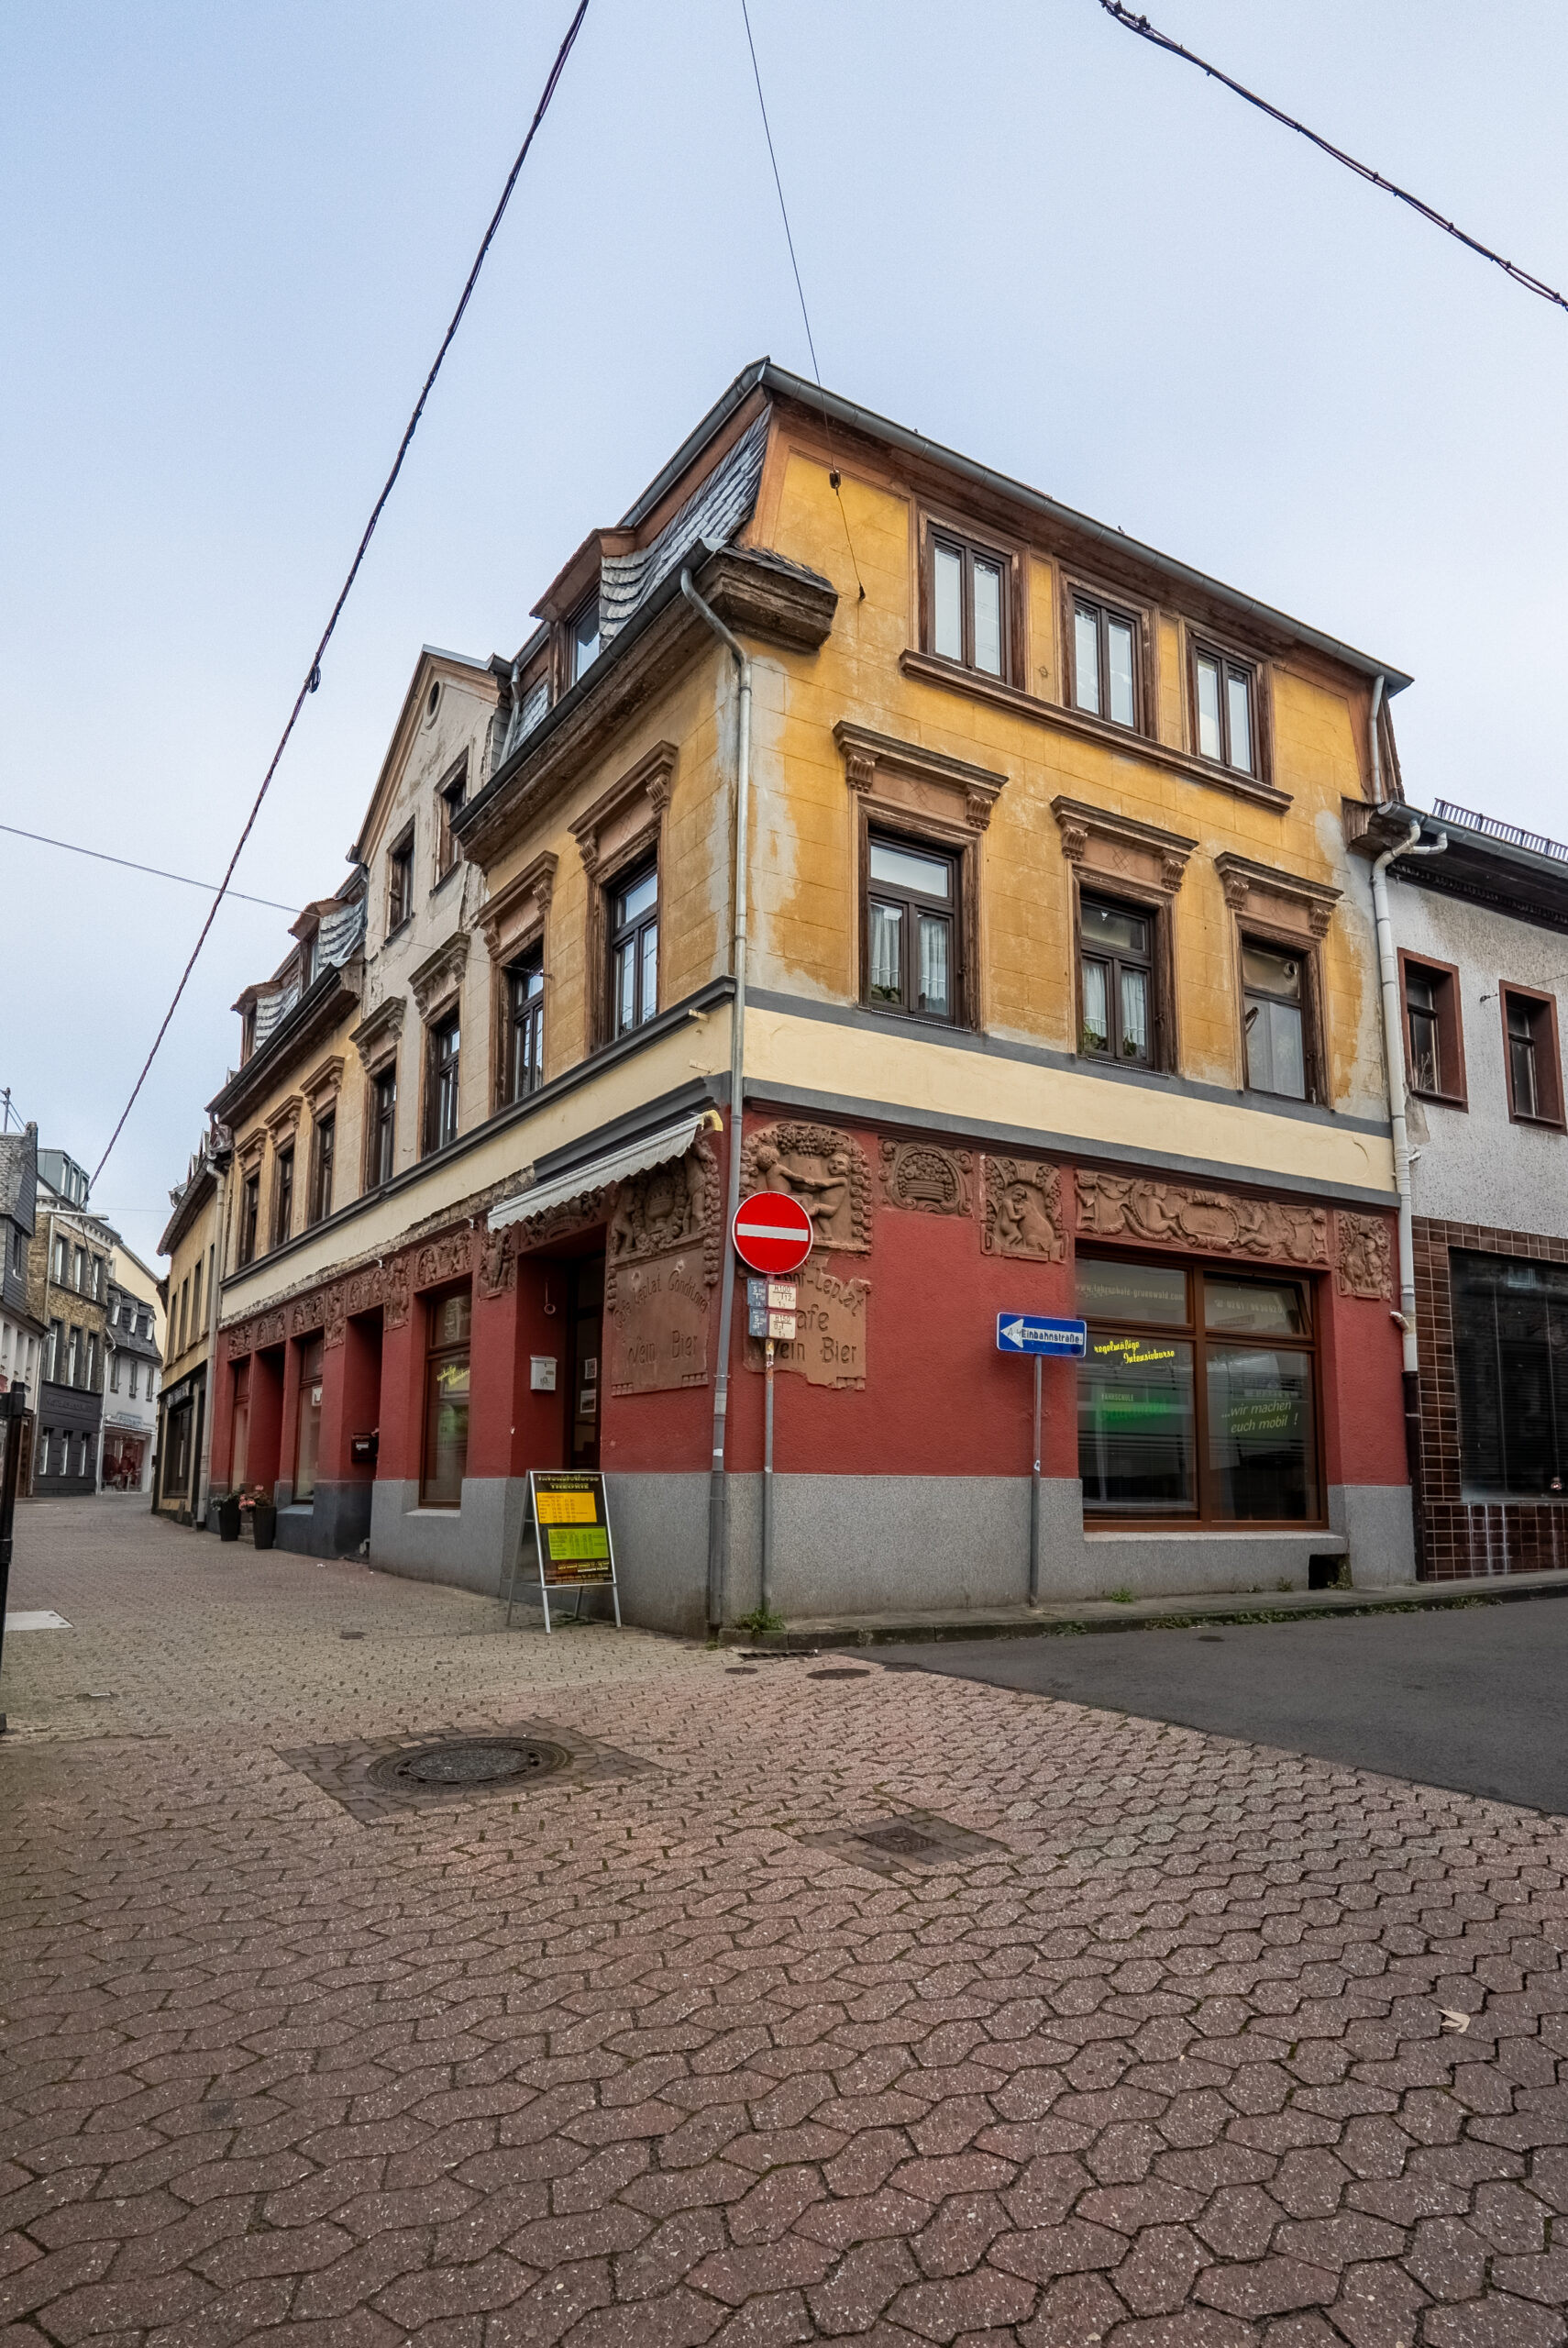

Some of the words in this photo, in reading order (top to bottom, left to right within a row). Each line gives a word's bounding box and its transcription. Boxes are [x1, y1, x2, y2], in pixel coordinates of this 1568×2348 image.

[633, 1269, 663, 1305] Leplat
[796, 1303, 829, 1332] afe
[671, 1330, 698, 1359] Bier
[821, 1336, 857, 1364] Bier
[1021, 1328, 1080, 1344] Einbahnstraße
[1250, 1401, 1292, 1414] machen
[1230, 1419, 1256, 1433] euch
[1258, 1415, 1288, 1430] mobil
